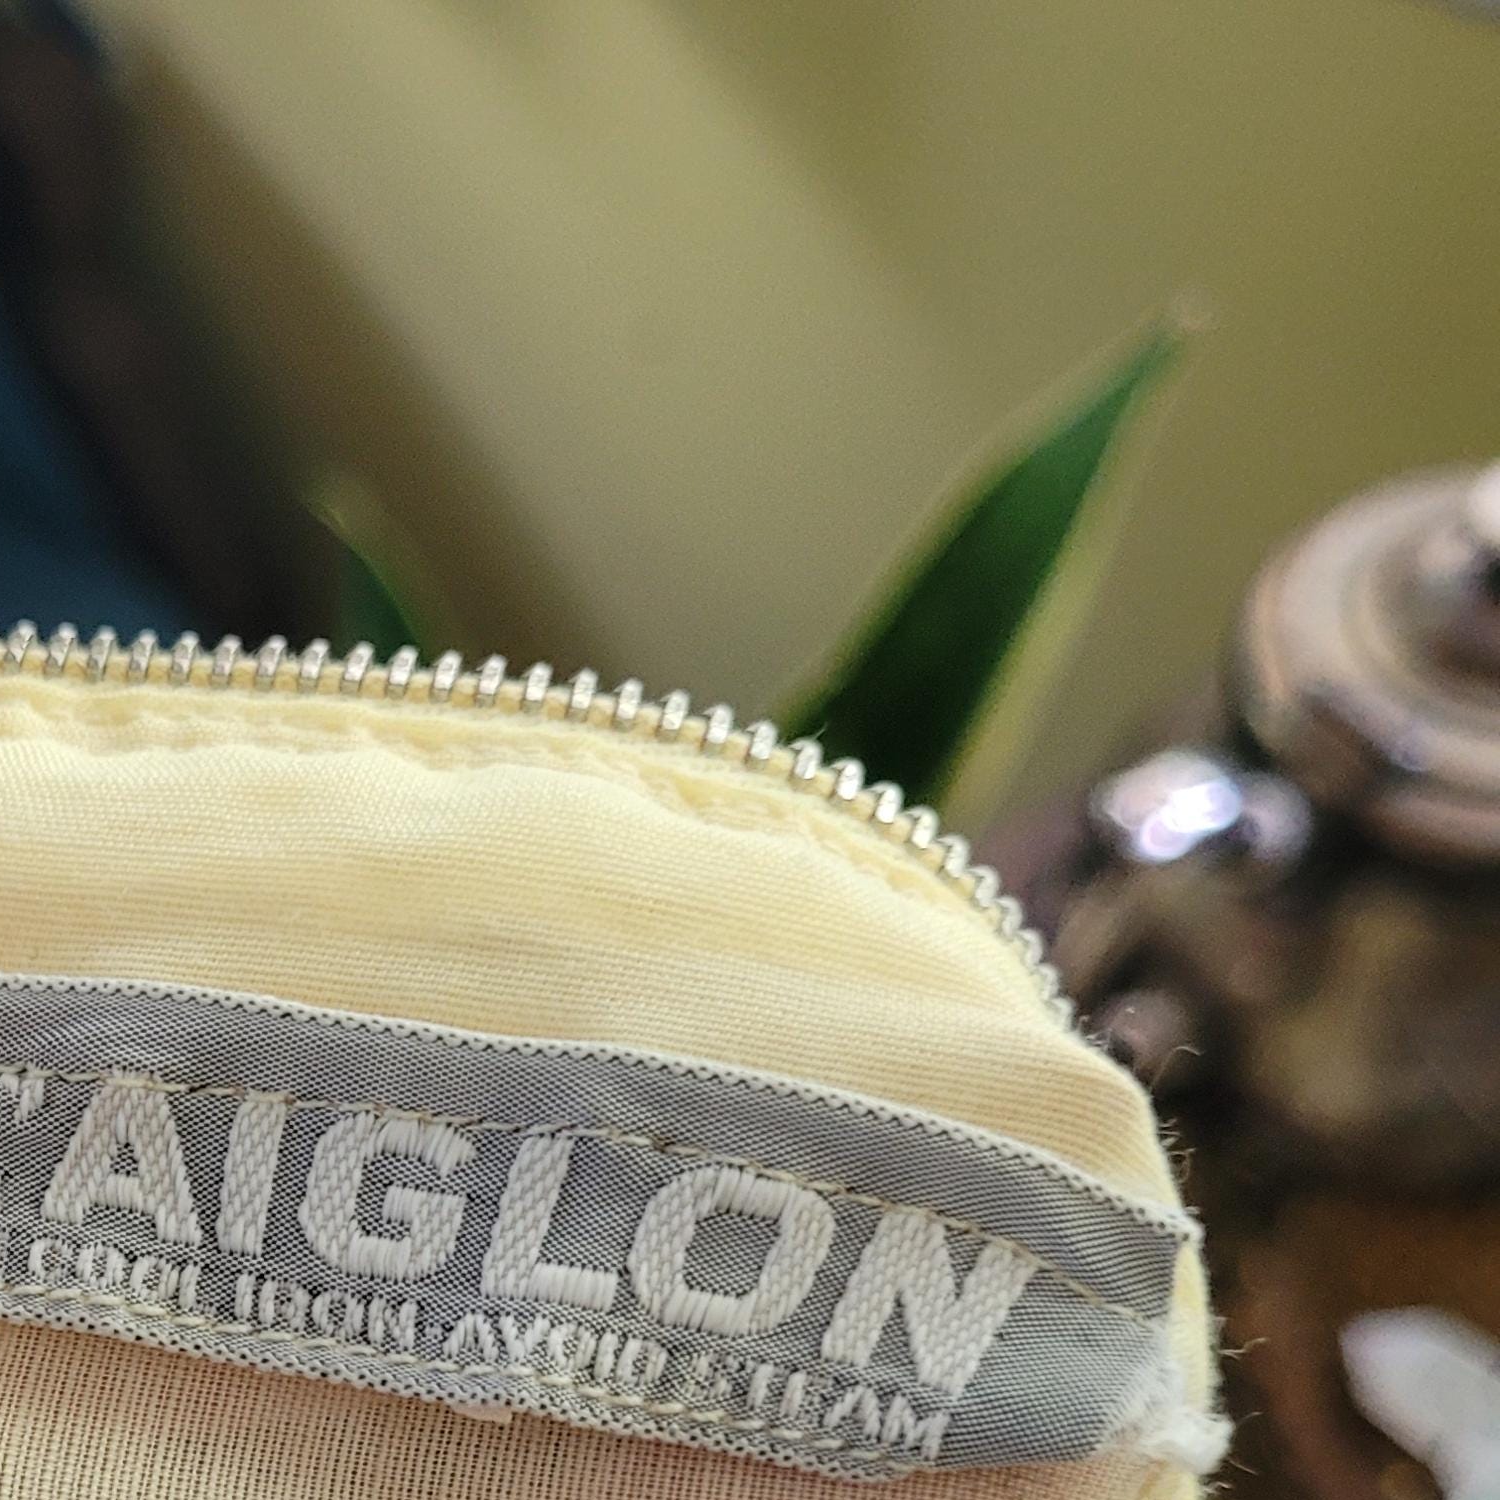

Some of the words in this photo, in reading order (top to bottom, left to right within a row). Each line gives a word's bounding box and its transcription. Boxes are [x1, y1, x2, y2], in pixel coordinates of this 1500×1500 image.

[235, 1272, 419, 1352] IRON
[442, 1312, 667, 1386] AVOID
[684, 1346, 951, 1462] STEAM
